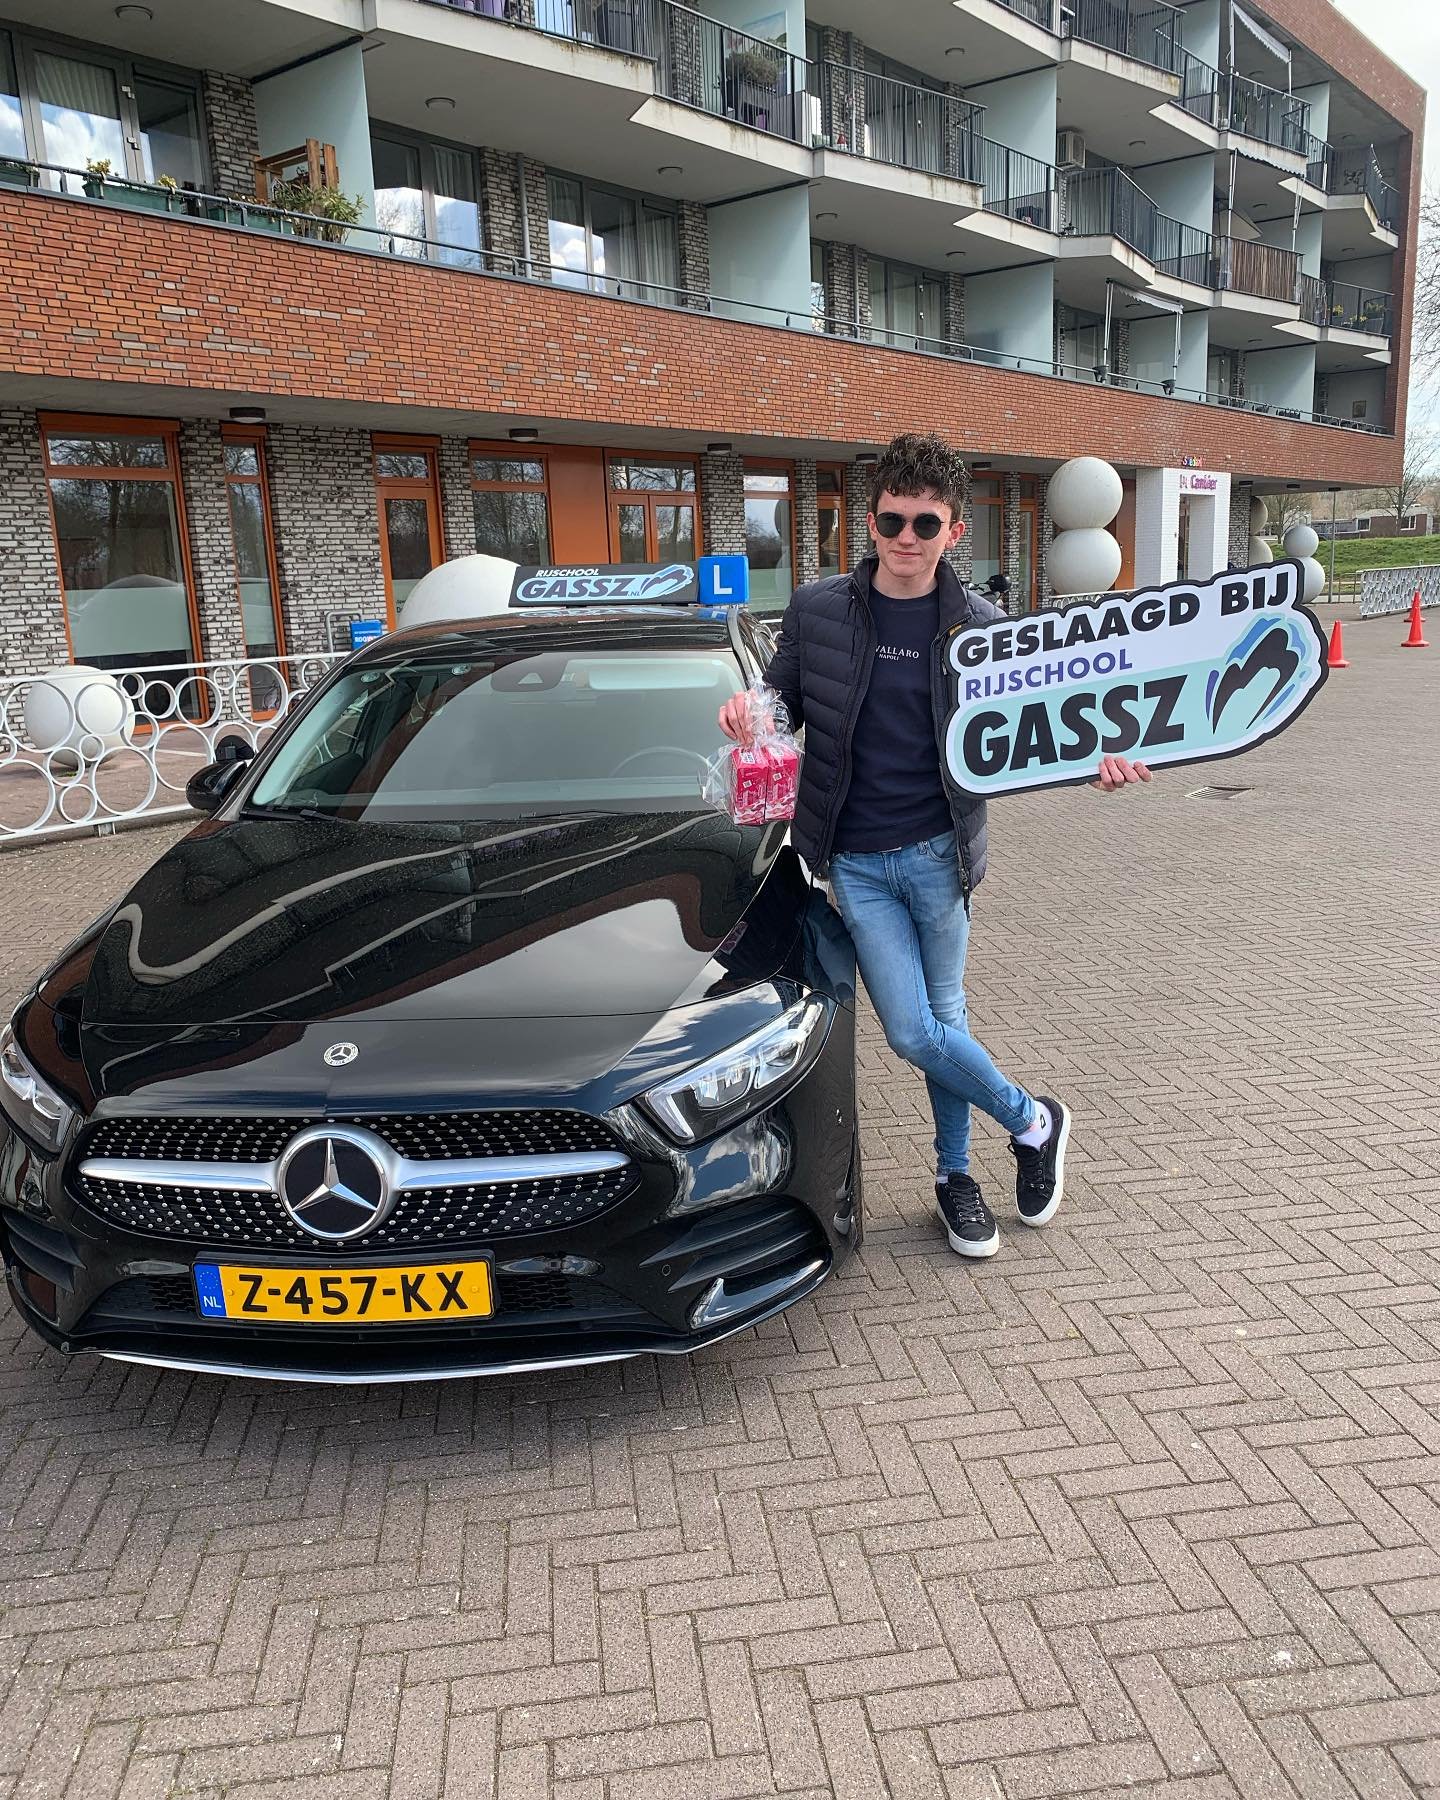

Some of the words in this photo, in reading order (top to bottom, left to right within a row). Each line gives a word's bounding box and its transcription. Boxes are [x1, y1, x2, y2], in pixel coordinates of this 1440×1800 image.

[535, 568, 600, 577] RIJSCHOOL
[714, 565, 733, 595] L
[521, 578, 635, 598] GASSZ
[956, 592, 1201, 667] GESLAAGD
[1220, 571, 1290, 617] BIJ
[879, 653, 899, 661] NAPOLI
[964, 648, 1133, 701] RIJSCHOOL
[962, 674, 1189, 777] GASSZ
[203, 1295, 222, 1309] NL
[238, 1270, 469, 1316] Z-457-KX
